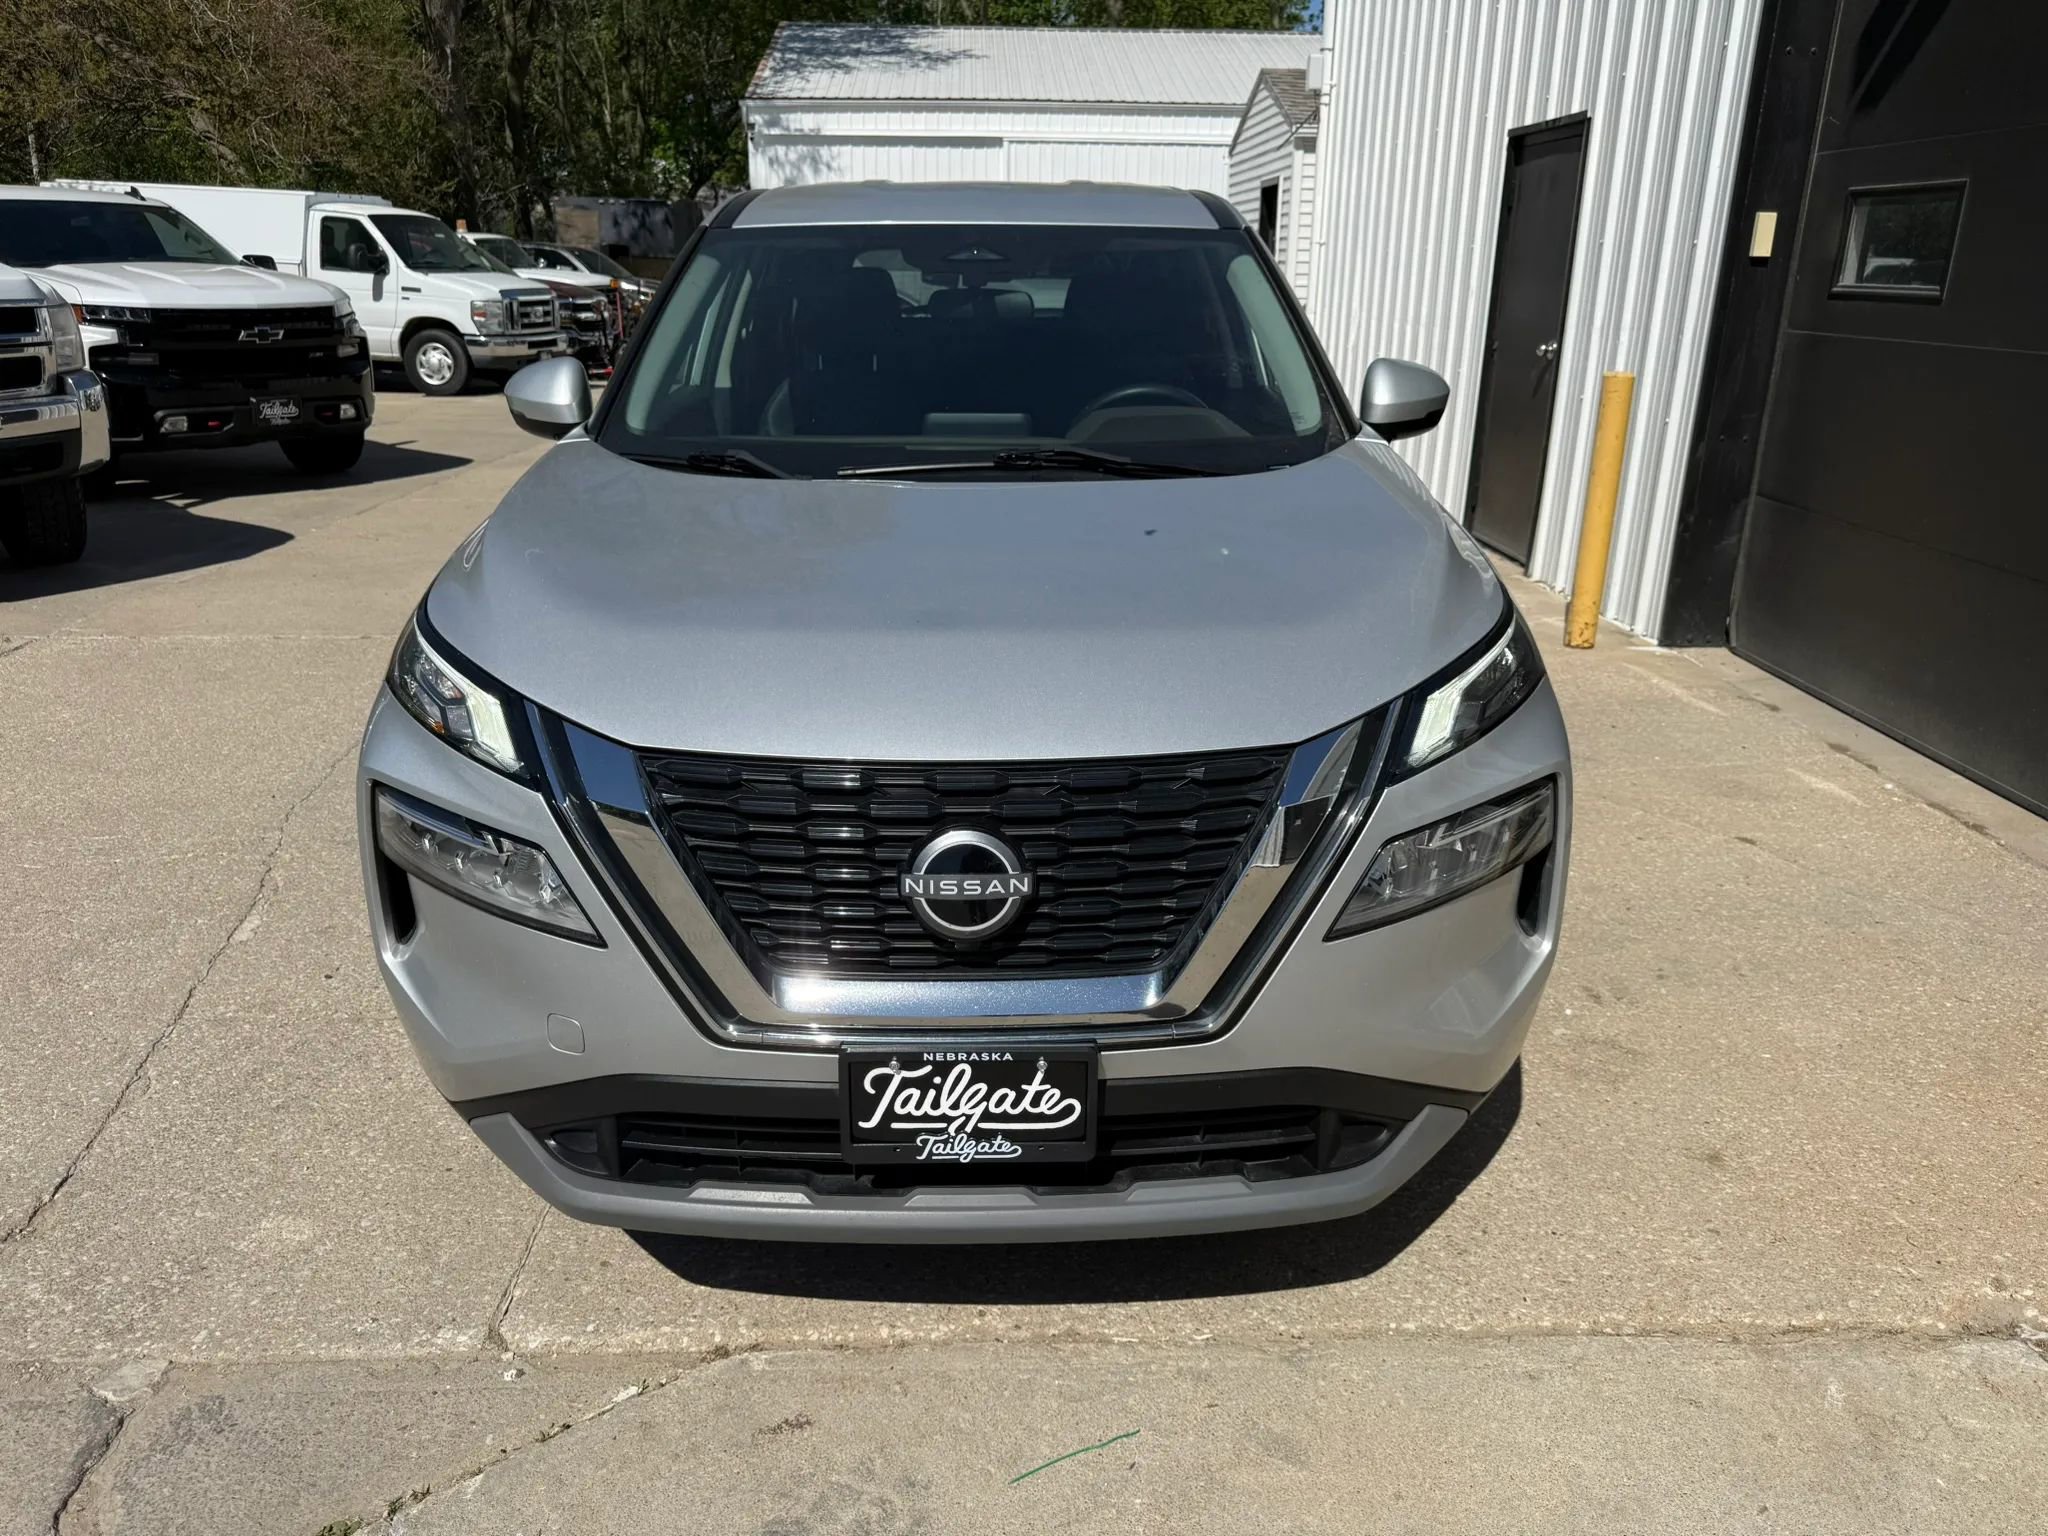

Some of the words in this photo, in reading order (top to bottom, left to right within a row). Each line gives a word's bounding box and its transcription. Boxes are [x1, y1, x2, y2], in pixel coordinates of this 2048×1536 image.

[904, 877, 1029, 896] NISSAN
[923, 1052, 1014, 1062] NEBRASKA
[858, 1062, 1082, 1135] Tailgate
[915, 1132, 1023, 1163] Tailgate
